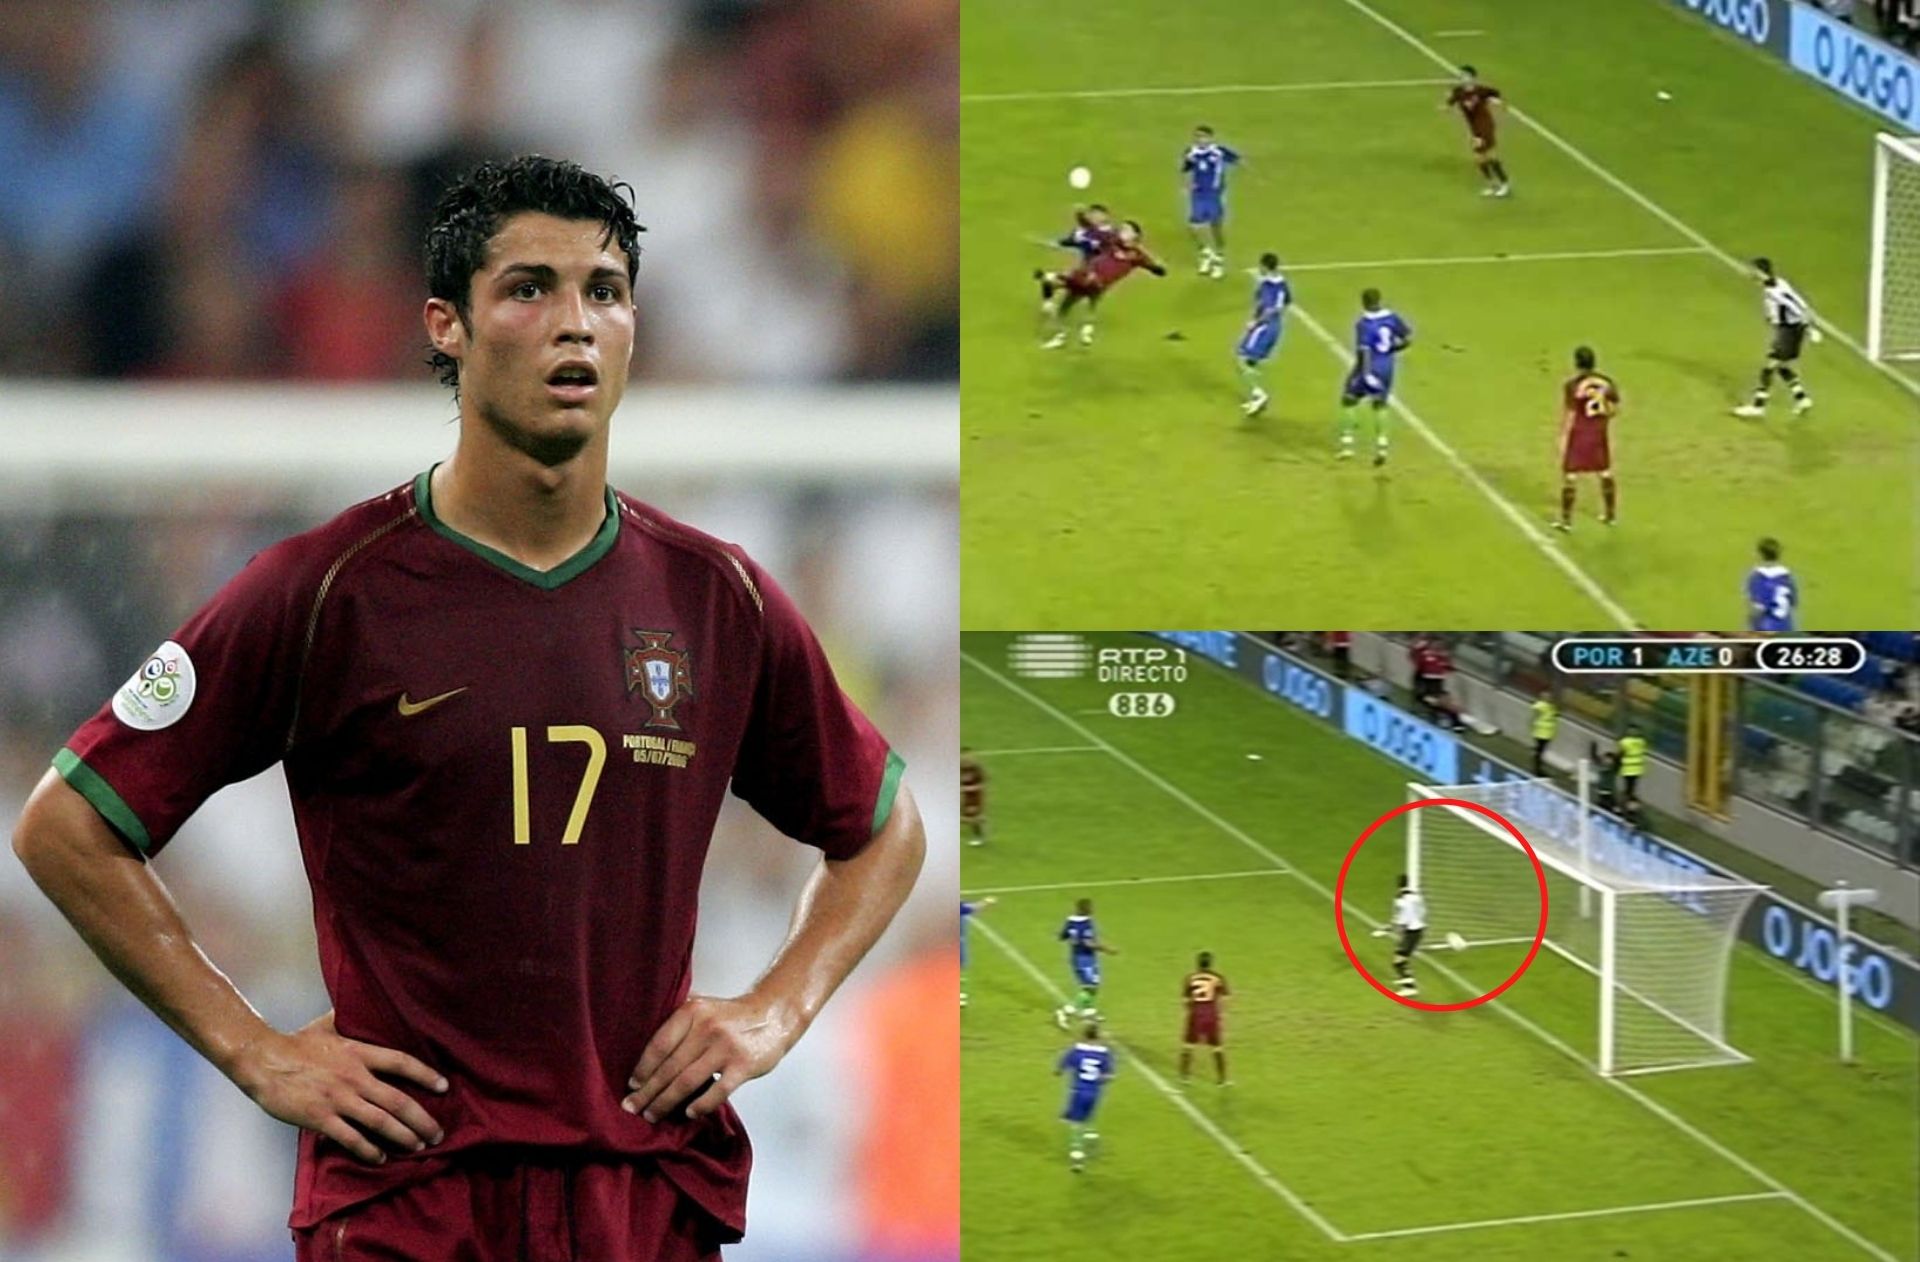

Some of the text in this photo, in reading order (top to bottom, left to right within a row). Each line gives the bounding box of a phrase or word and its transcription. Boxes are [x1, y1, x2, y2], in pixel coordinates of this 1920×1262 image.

[1815, 26, 1913, 120] O JOGO
[1377, 326, 1391, 352] 3
[1772, 585, 1791, 618] 5
[511, 725, 607, 845] 17
[1763, 905, 1893, 1009] O JOGO
[1079, 1058, 1101, 1081] 5
